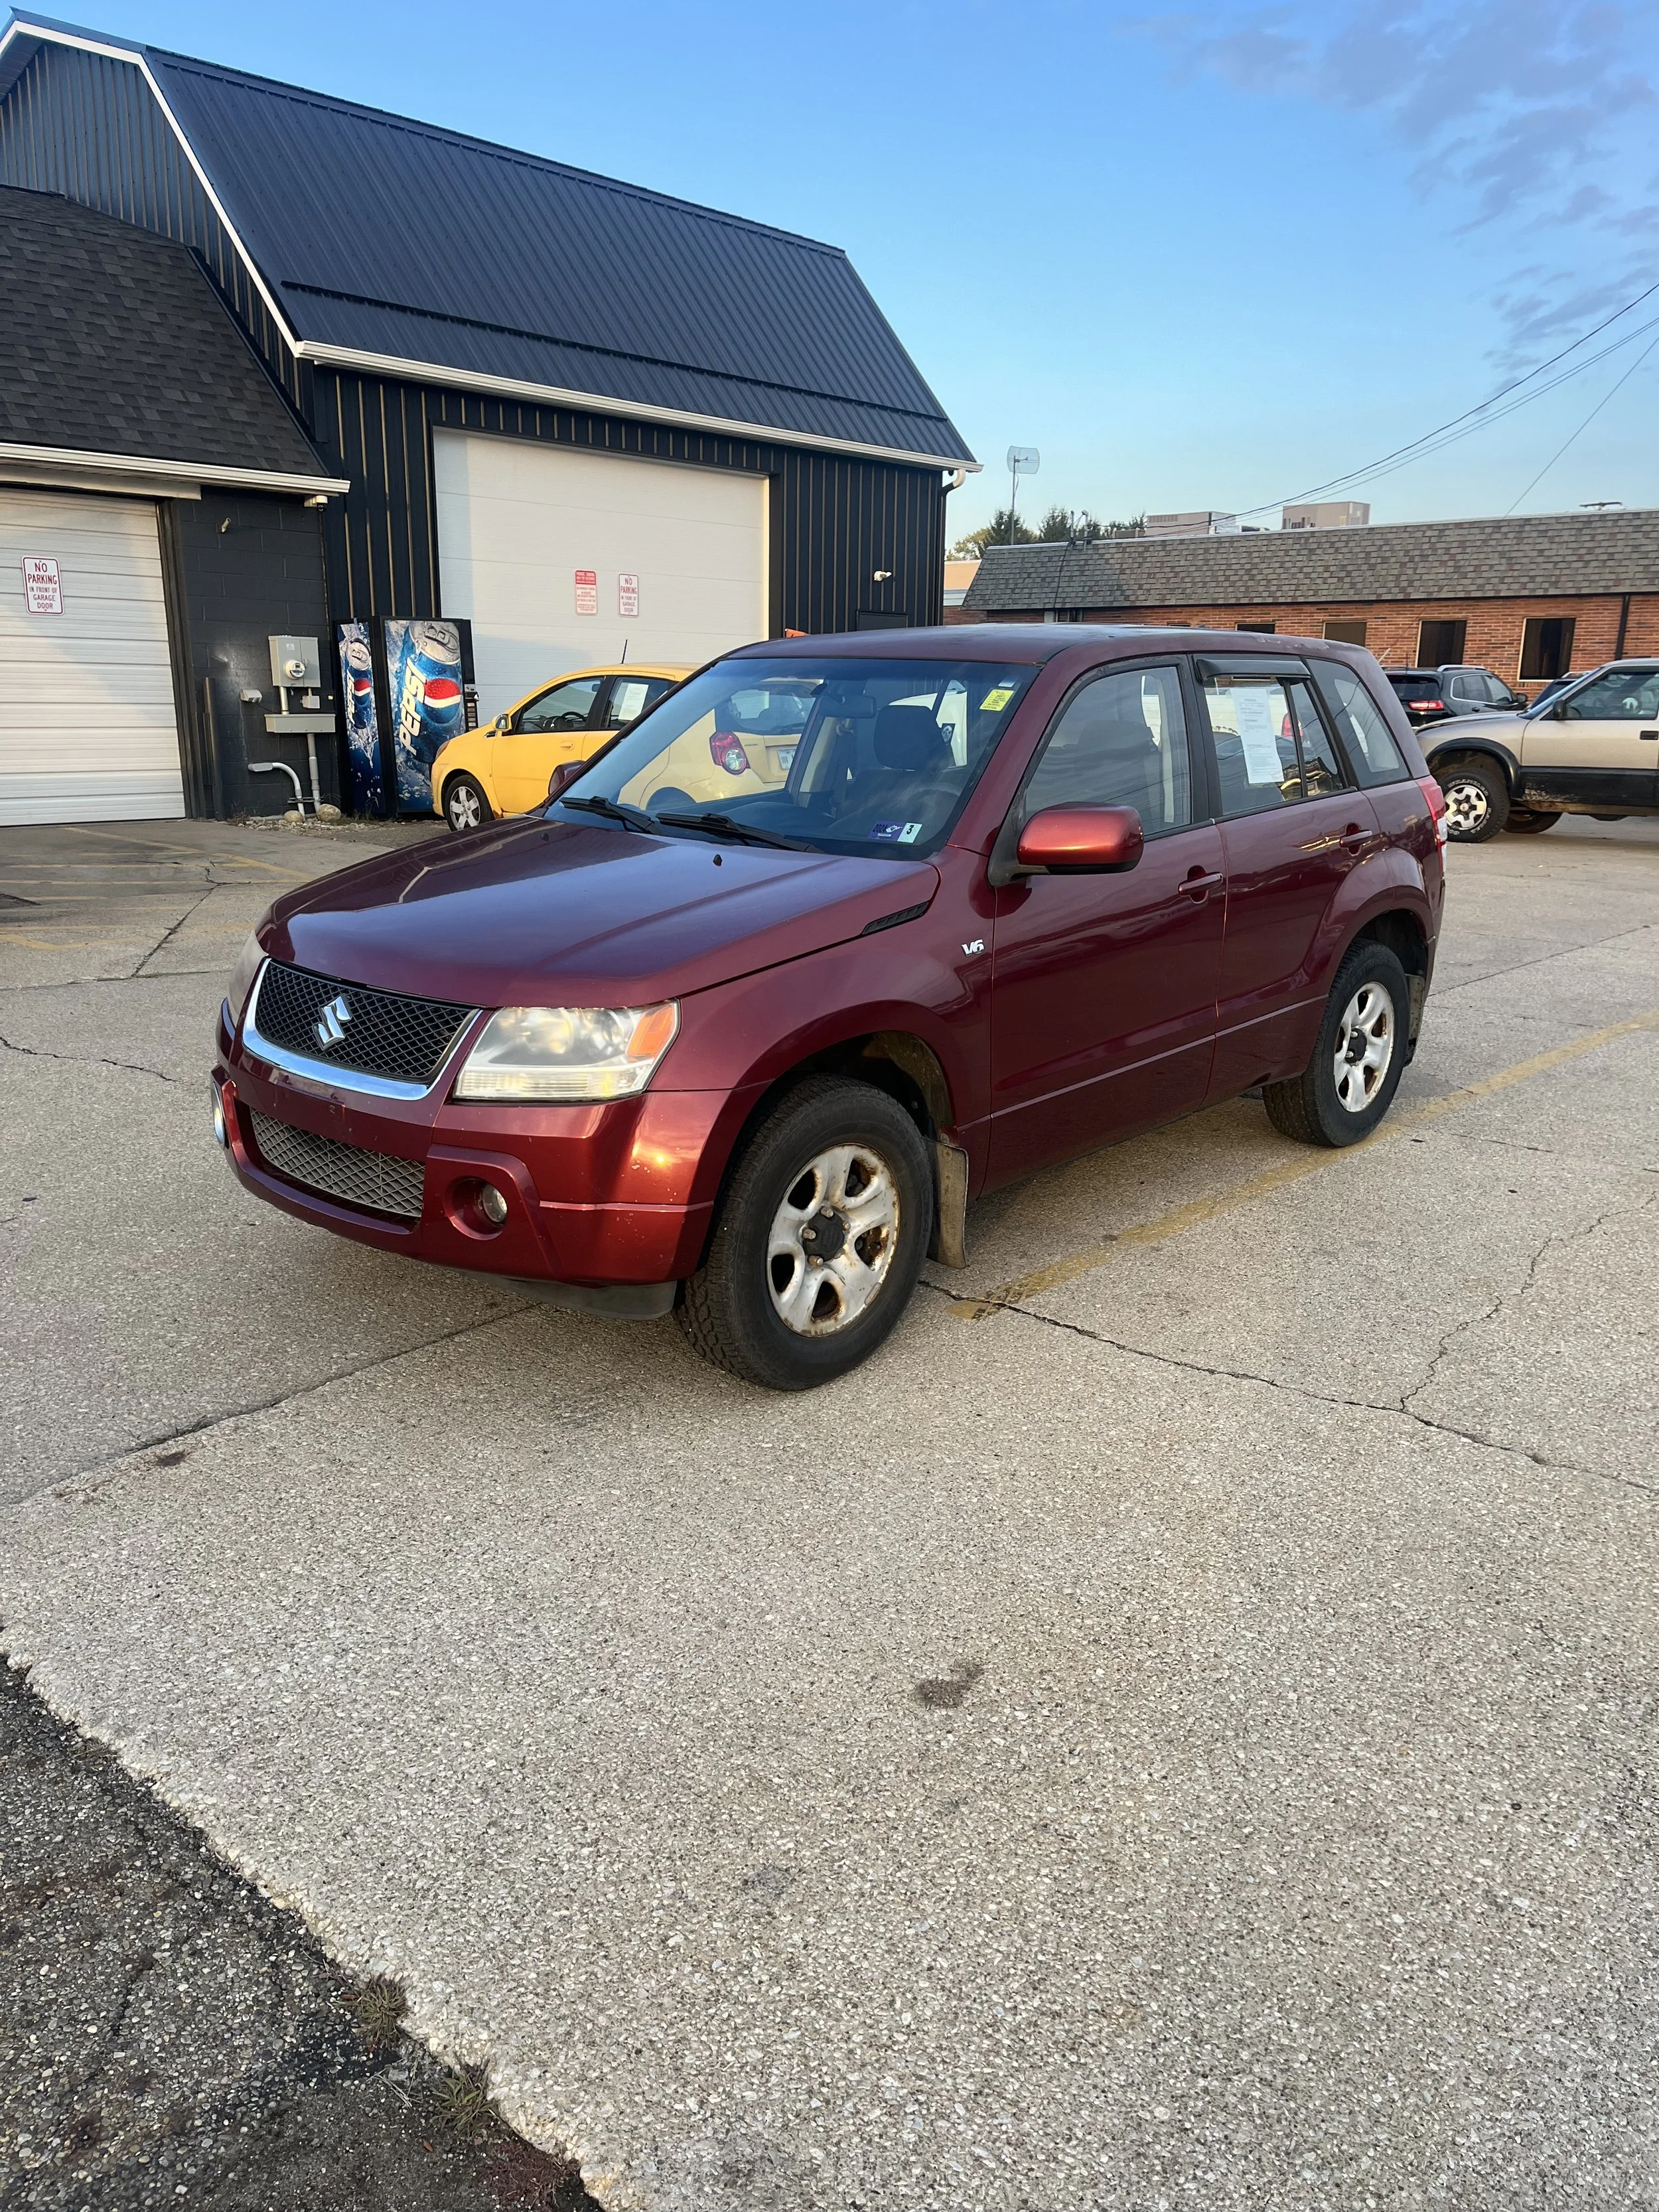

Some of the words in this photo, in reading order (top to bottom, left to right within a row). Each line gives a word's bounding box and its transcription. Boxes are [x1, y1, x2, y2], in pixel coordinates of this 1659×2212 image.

[35, 562, 48, 572] NO
[28, 573, 57, 585] PARKING
[620, 585, 637, 594] PARKING
[346, 668, 356, 725] PEPSI
[398, 656, 427, 757] PEPSI
[906, 824, 915, 835] 3
[961, 939, 985, 956] V6
